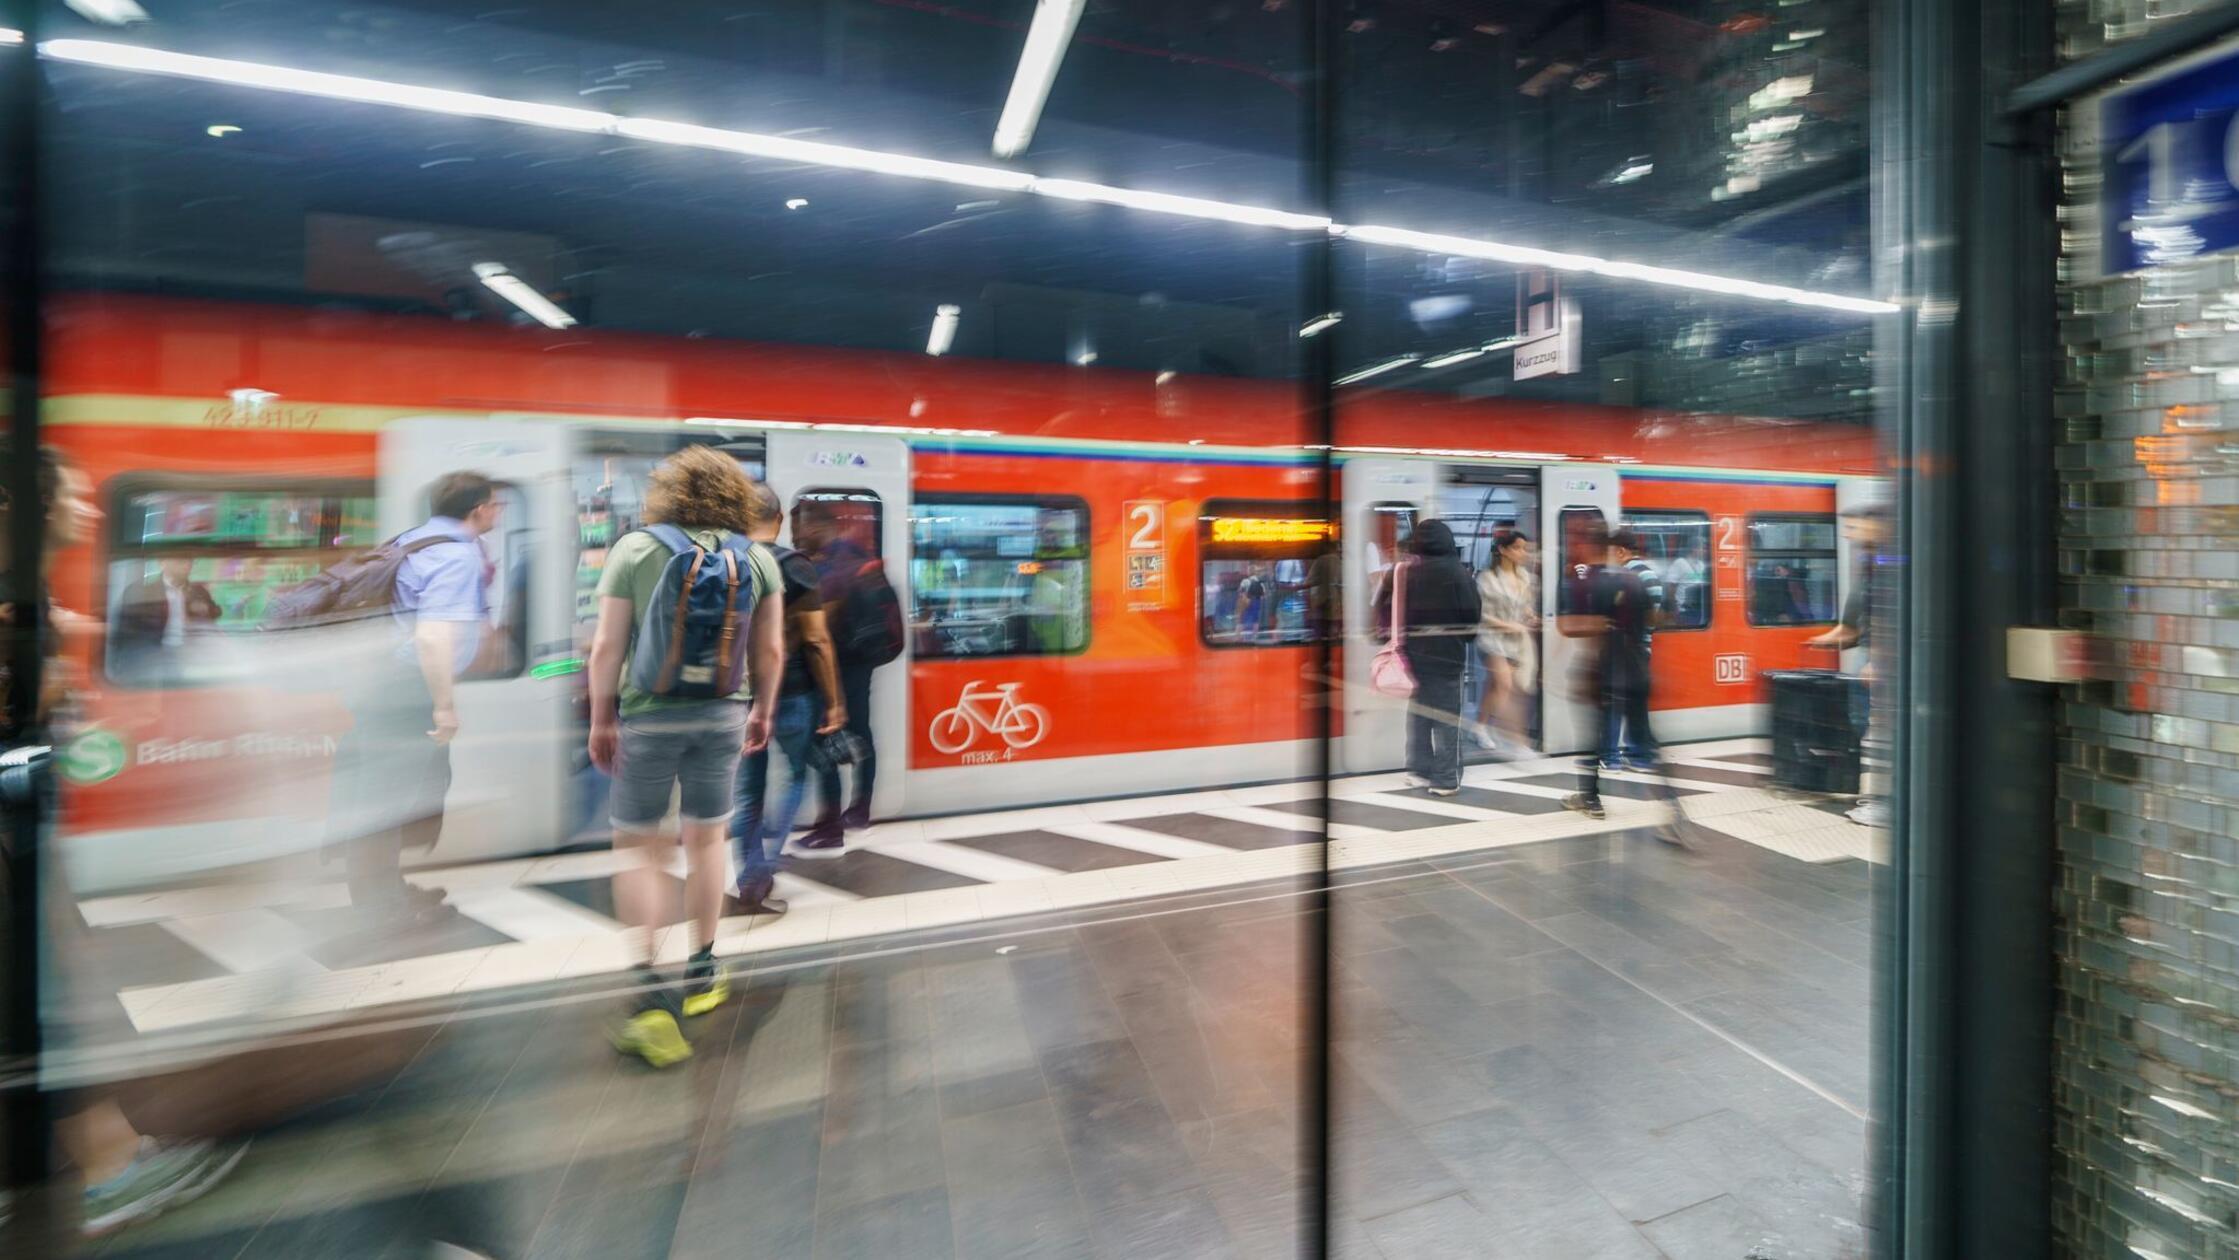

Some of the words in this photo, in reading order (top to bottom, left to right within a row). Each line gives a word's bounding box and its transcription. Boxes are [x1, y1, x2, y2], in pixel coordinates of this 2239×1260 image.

[2116, 106, 2239, 203] 1
[1515, 350, 1558, 370] Kurzzug
[1129, 505, 1163, 549] 2
[1718, 516, 1738, 550] 2
[1717, 658, 1742, 680] DB
[67, 734, 113, 781] S
[961, 750, 999, 767] max.
[1002, 746, 1013, 763] 4
